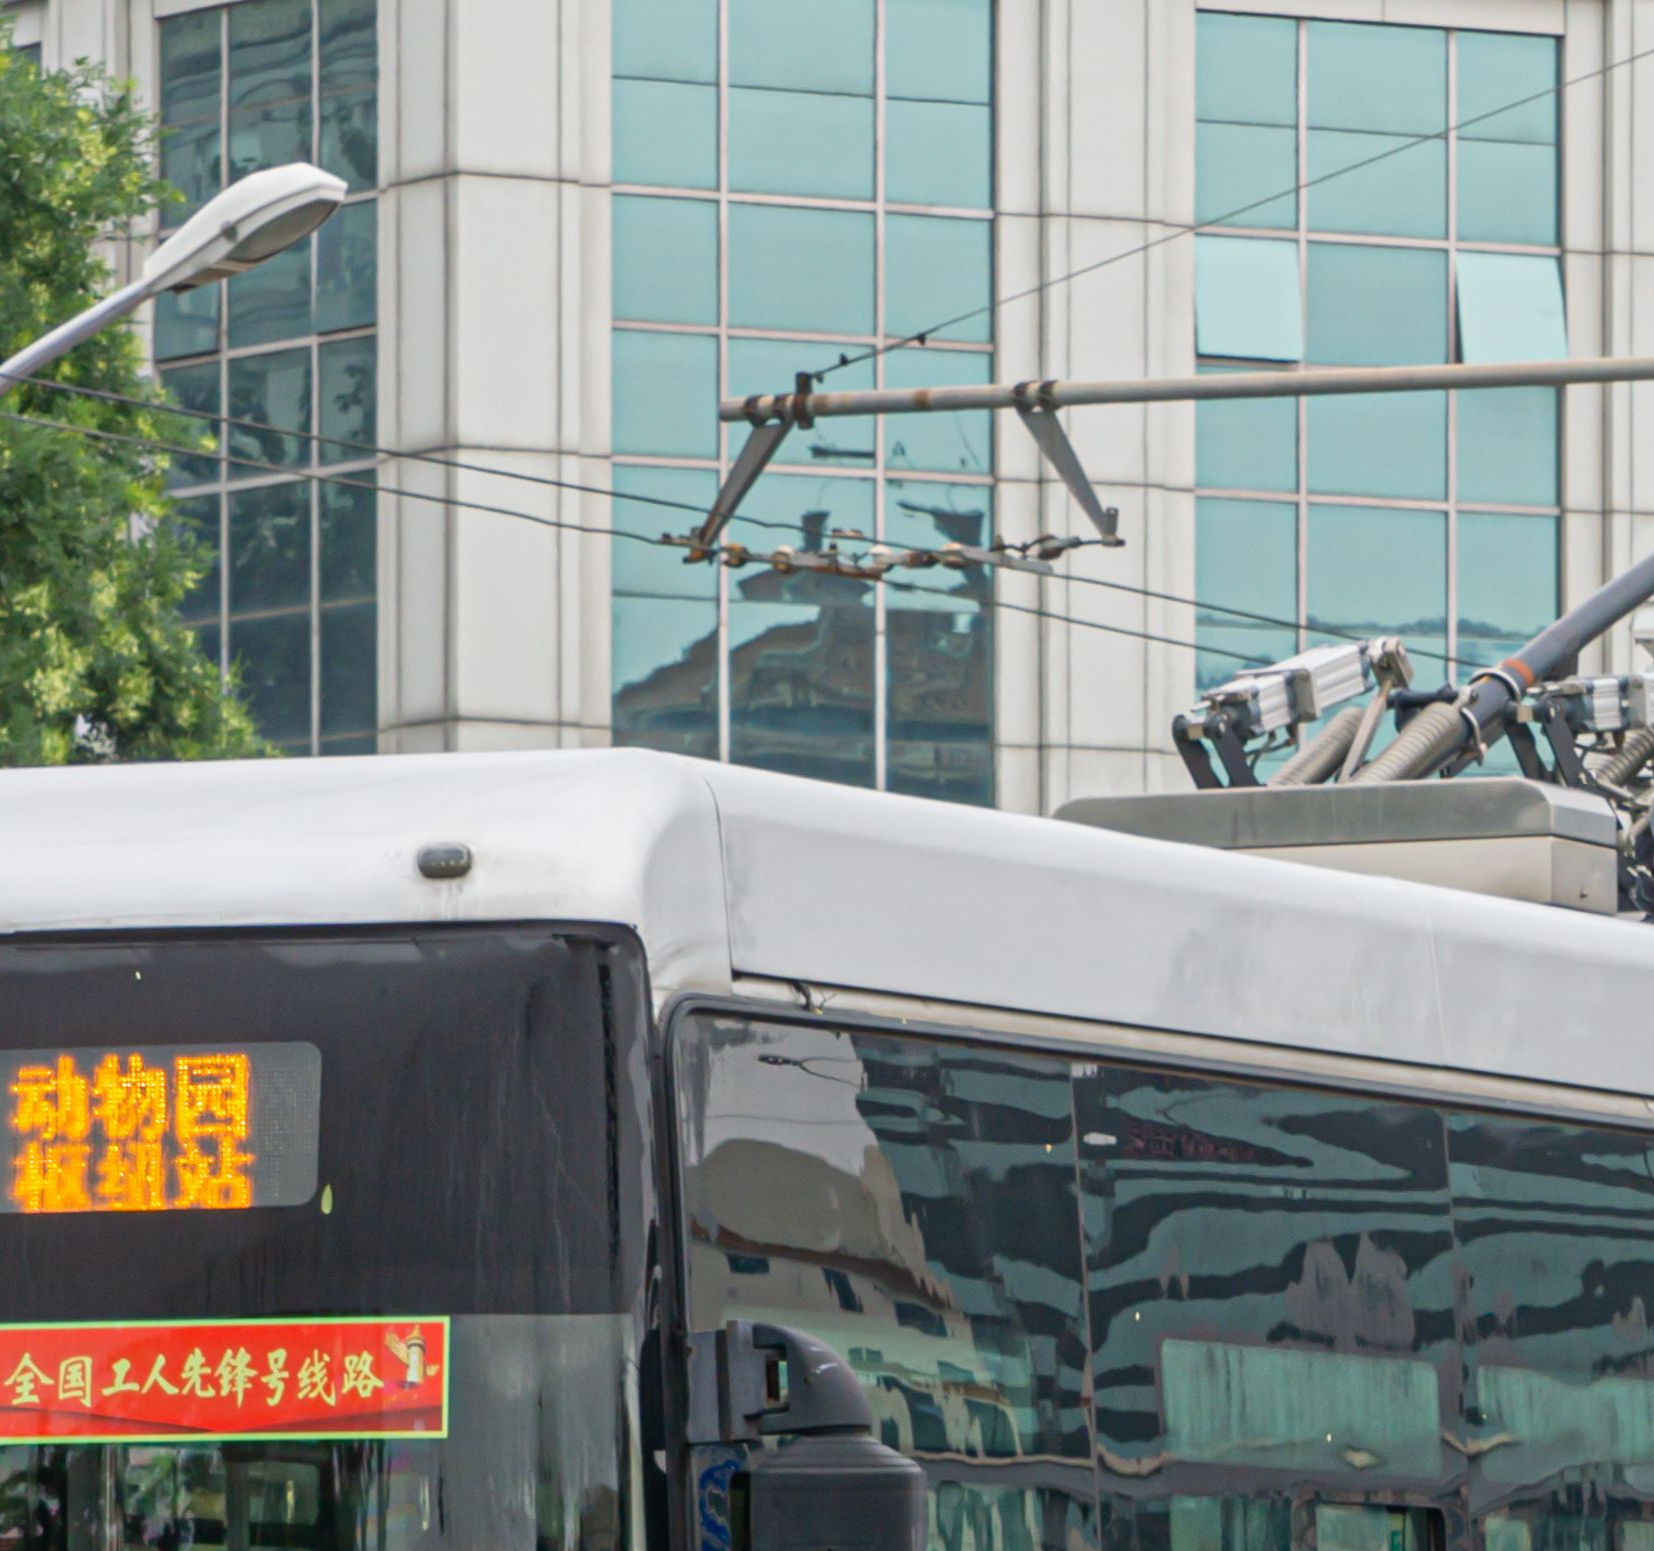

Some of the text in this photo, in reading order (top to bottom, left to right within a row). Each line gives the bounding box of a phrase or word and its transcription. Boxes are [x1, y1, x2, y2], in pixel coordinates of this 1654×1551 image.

[8, 1053, 252, 1140] 动物园
[3, 1347, 385, 1408] 全国工人先锋号线路
